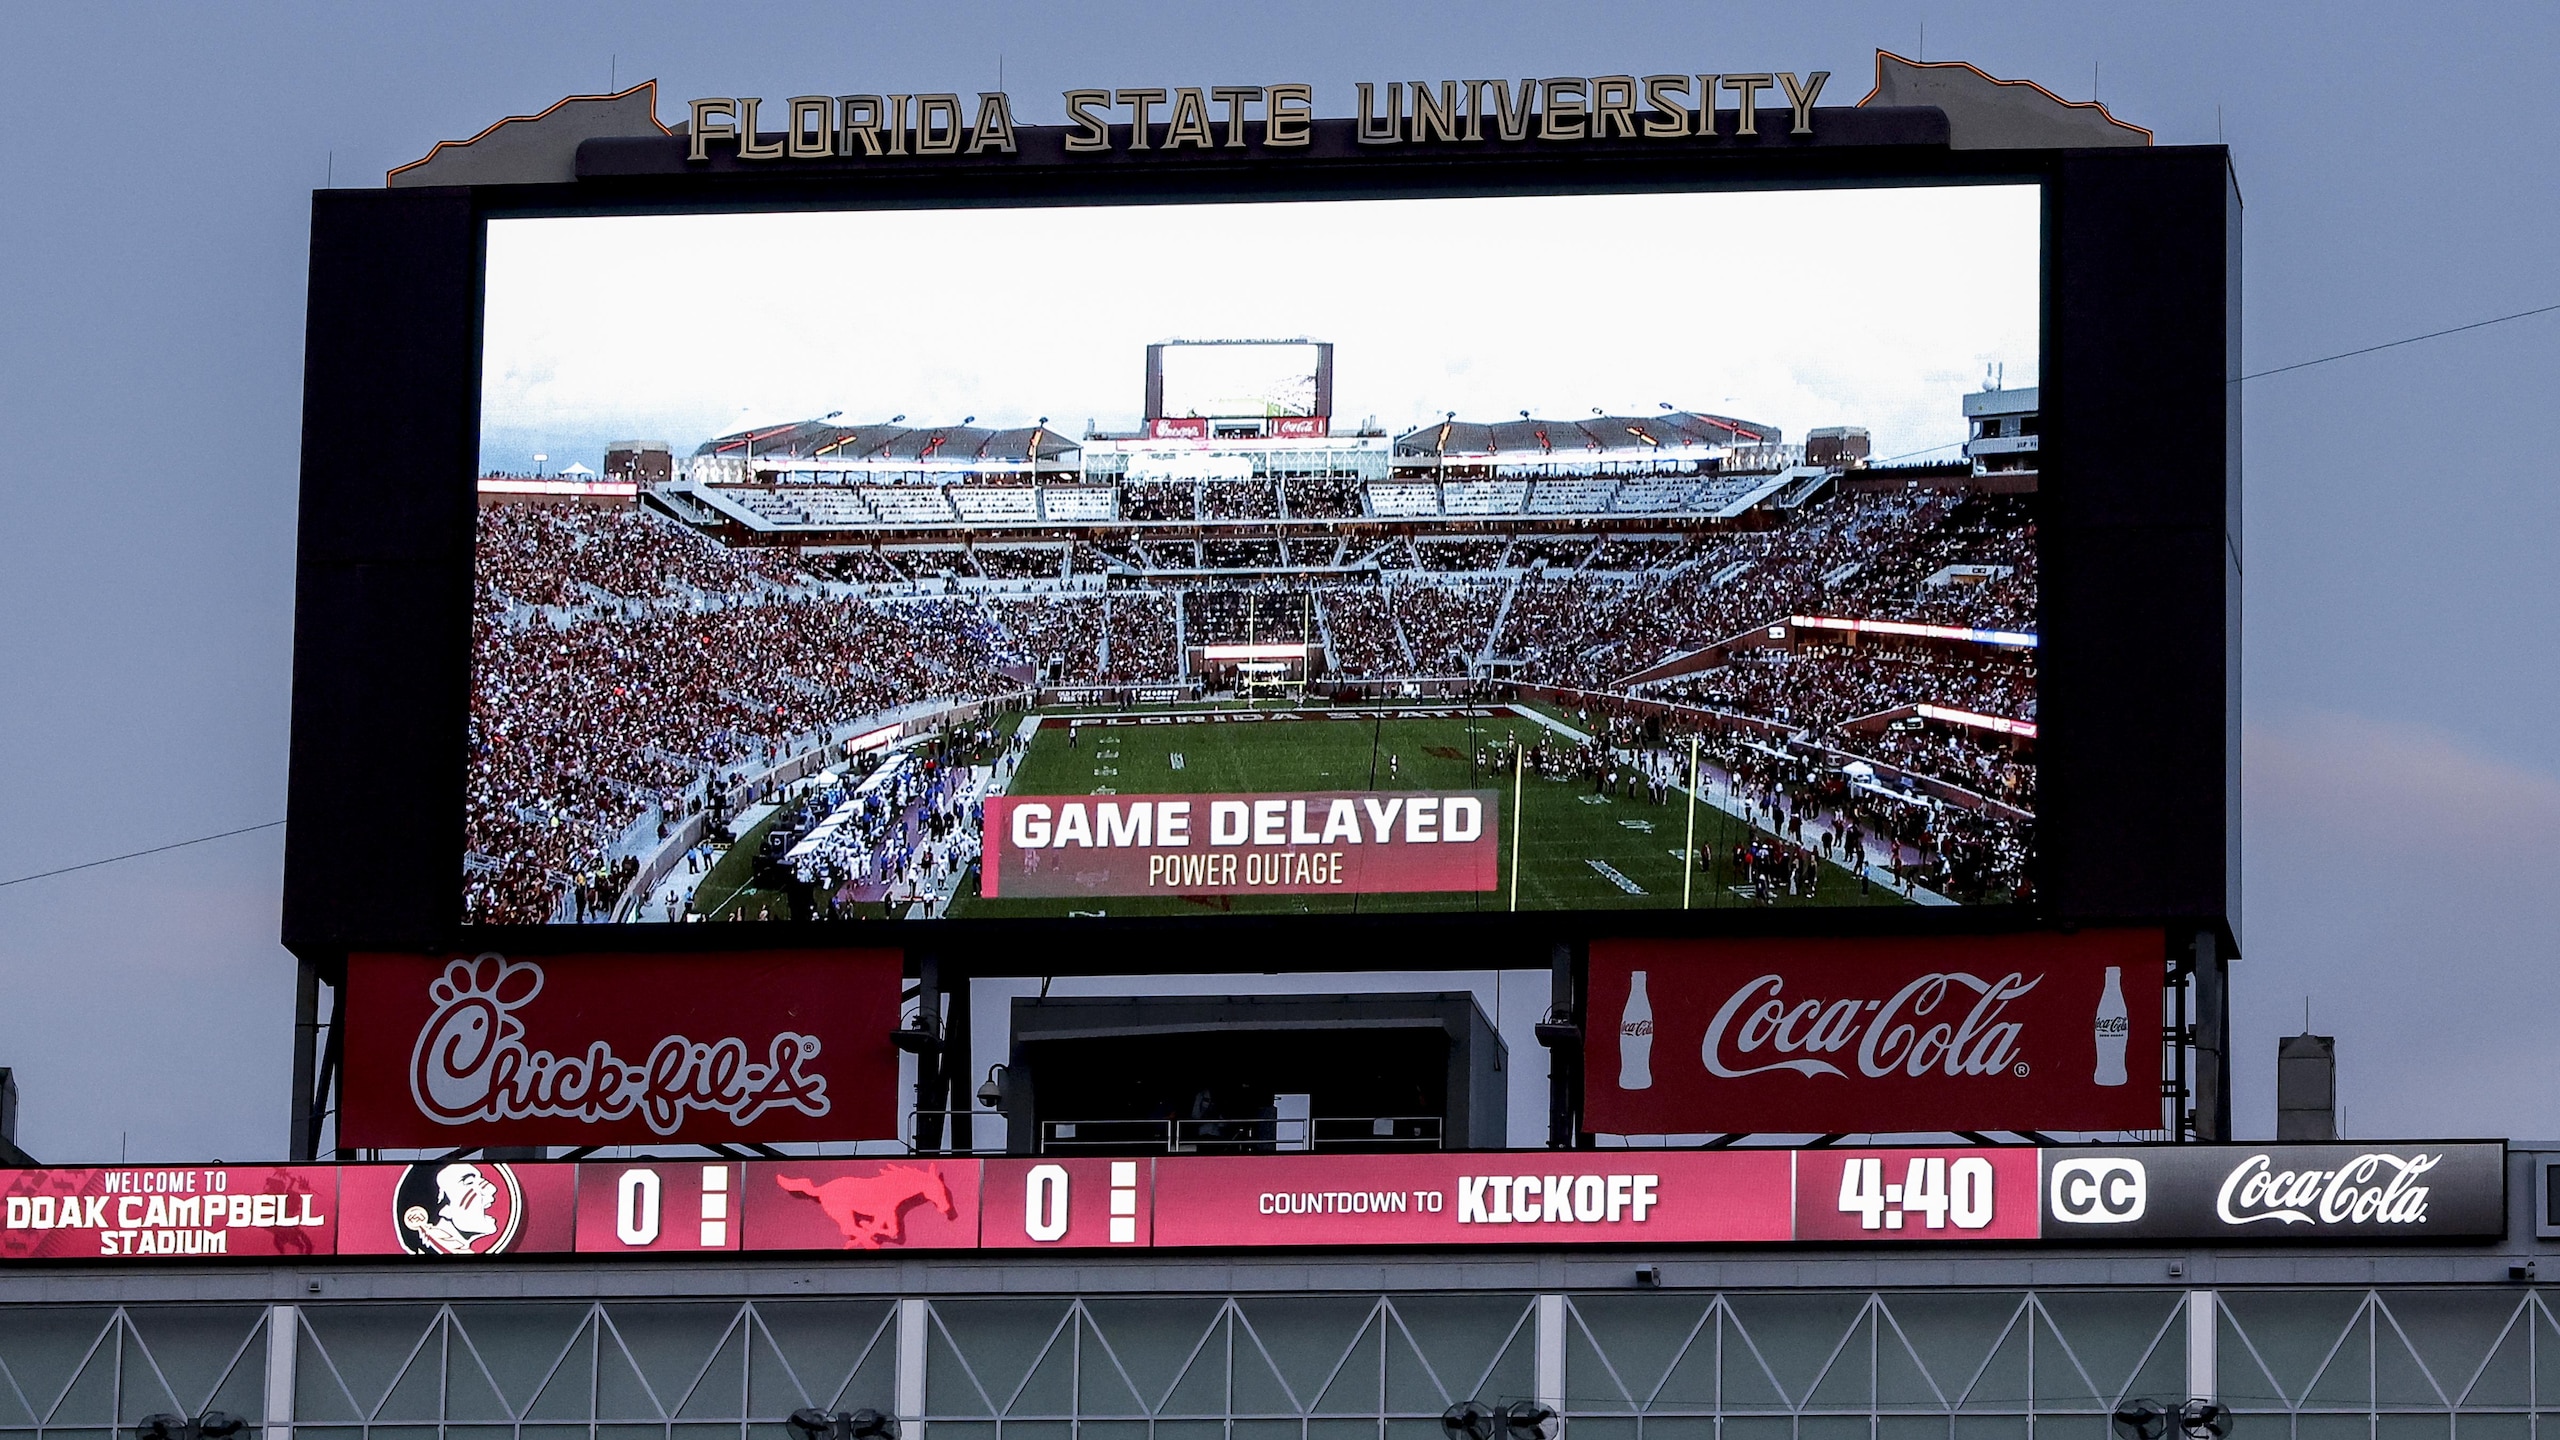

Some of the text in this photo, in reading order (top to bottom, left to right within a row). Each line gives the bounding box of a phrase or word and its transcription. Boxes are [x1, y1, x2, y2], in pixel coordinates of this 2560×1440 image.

[687, 71, 1831, 160] FLORIDA STATE UNIVERSITY
[1011, 797, 1483, 848] GAME DELAYED
[1149, 852, 1344, 887] POWER OUTAGE
[410, 951, 831, 1135] Chick-fil-A
[1701, 972, 2045, 1080] Coca-Cola
[6, 1194, 325, 1229] DOAK CAMPBELL
[105, 1170, 227, 1194] WELCOME TO
[616, 1168, 661, 1246] 0
[1025, 1164, 1069, 1242] 0
[1259, 1174, 1660, 1224] COUNTDOWN TO KICKOFF
[1837, 1157, 1994, 1230] 4:40
[2060, 1168, 2137, 1214] CC
[2217, 1153, 2444, 1225] Coca-Cola
[100, 1229, 227, 1255] STADIUM
